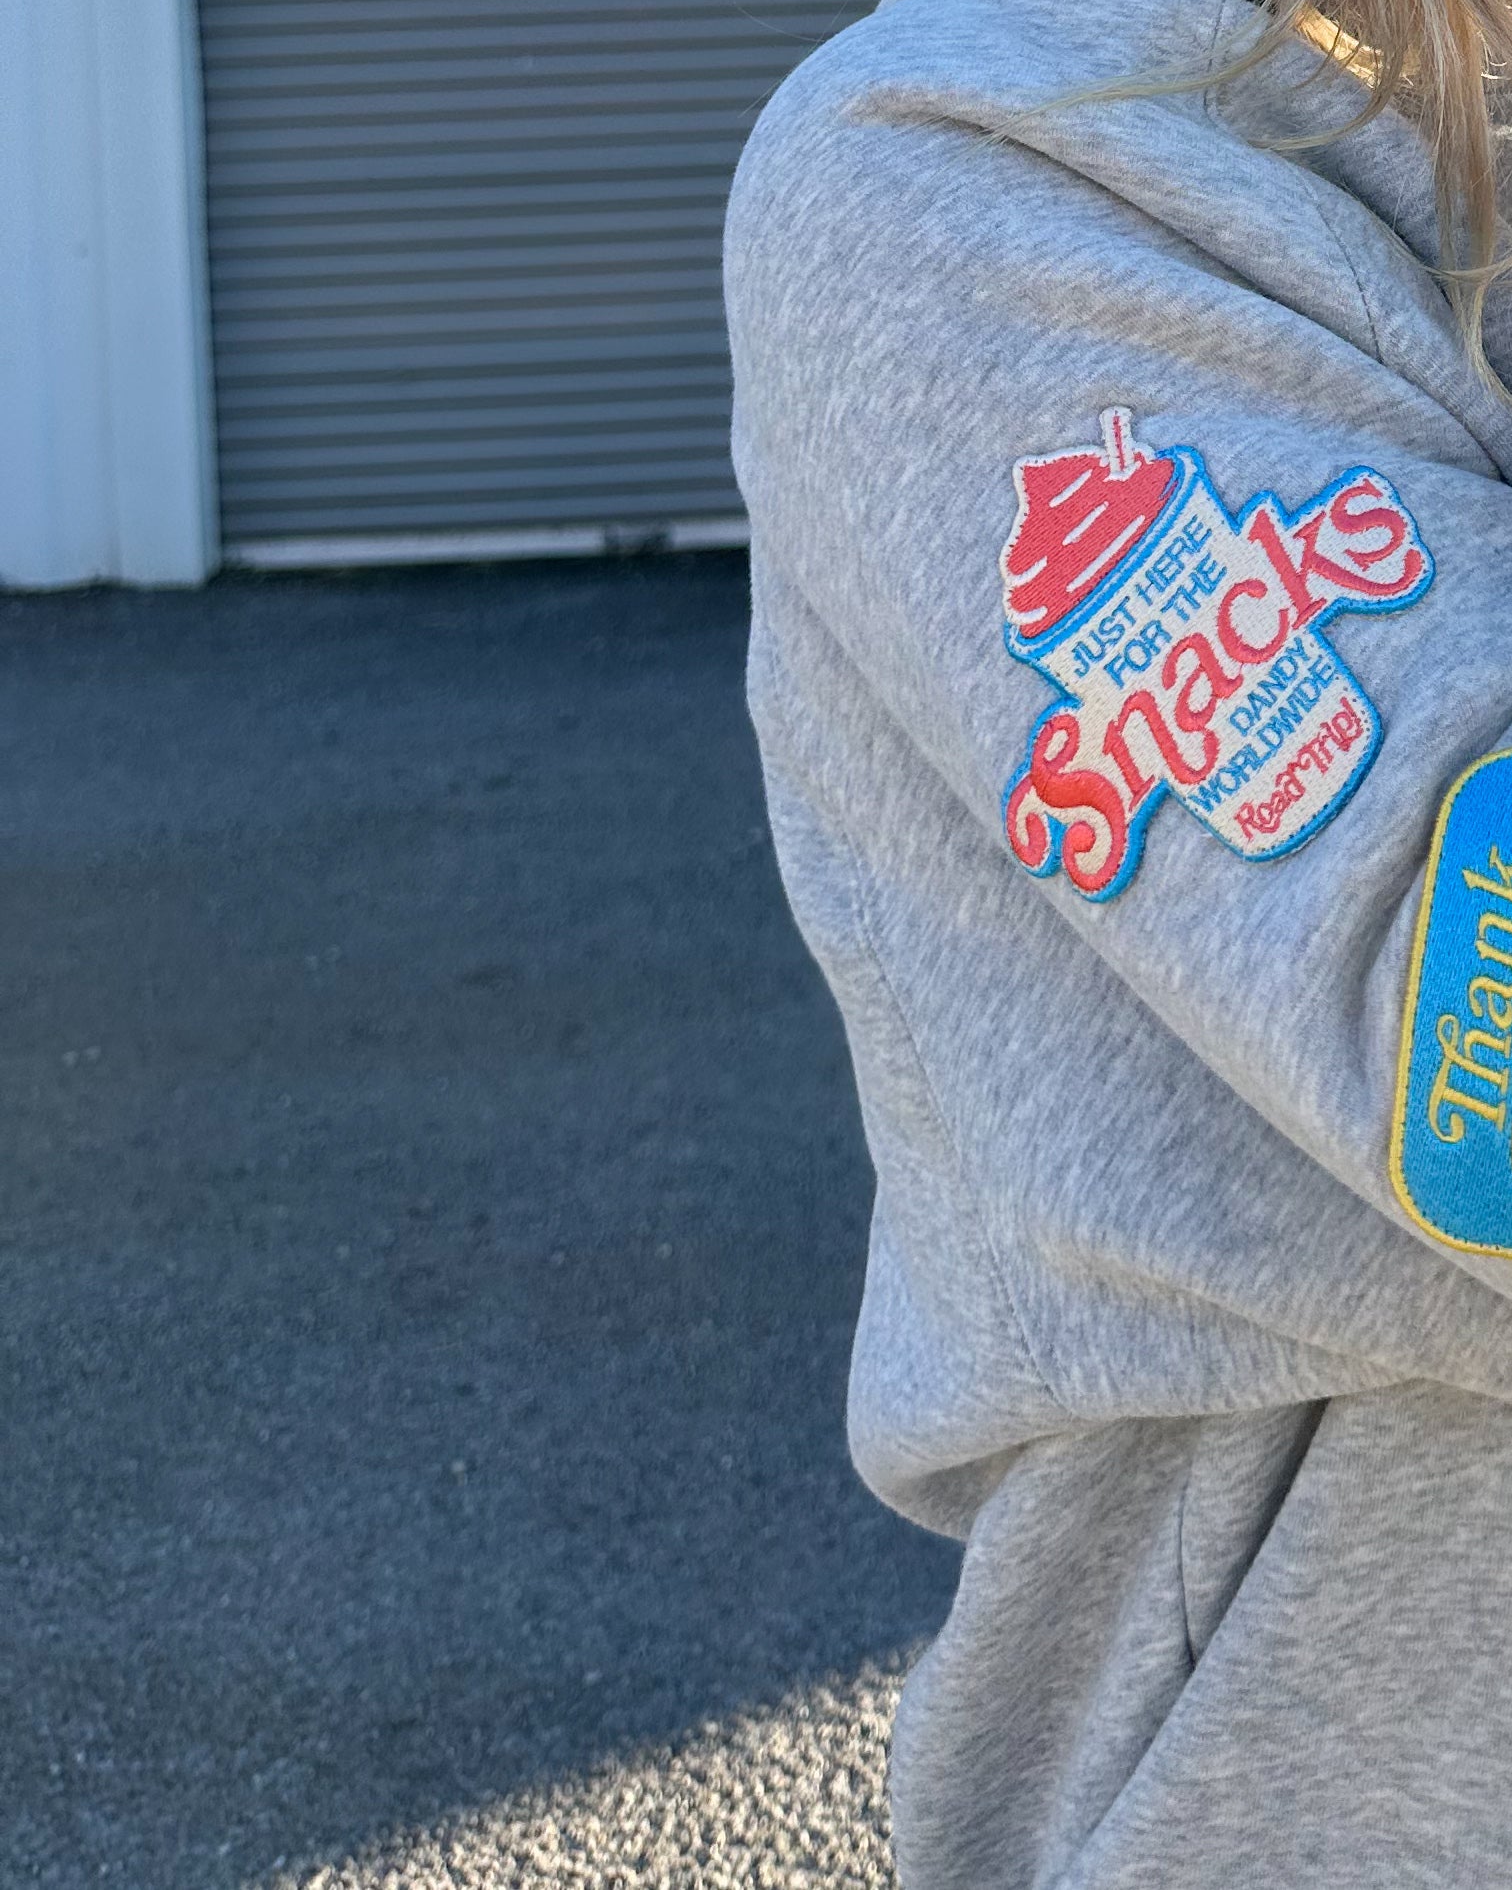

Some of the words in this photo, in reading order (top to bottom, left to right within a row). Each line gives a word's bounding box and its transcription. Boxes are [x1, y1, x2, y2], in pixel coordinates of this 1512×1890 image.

[1071, 596, 1132, 678] JUST
[1138, 514, 1214, 605] HERE
[1105, 623, 1173, 690] FOR
[1160, 552, 1227, 623] THE
[1006, 477, 1424, 893] Snacks
[1189, 660, 1335, 813] WORLDWIDE
[1230, 636, 1309, 737] DANDY
[1233, 765, 1308, 844] Road
